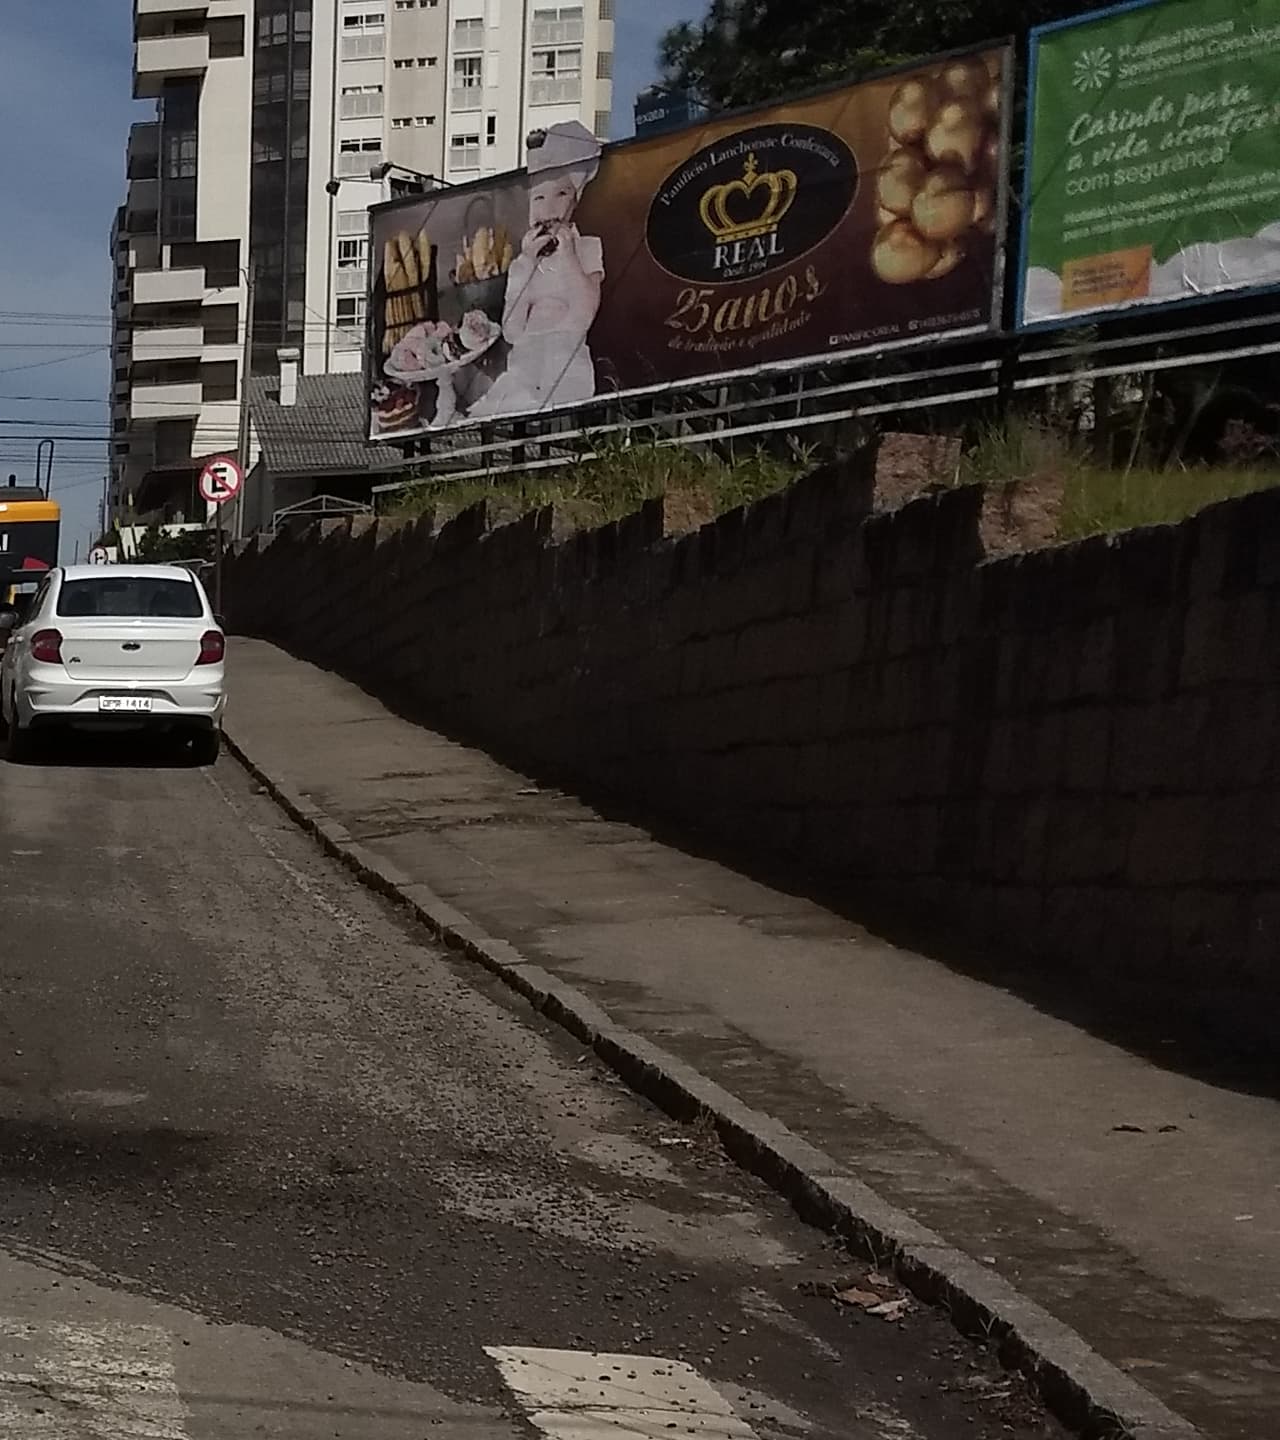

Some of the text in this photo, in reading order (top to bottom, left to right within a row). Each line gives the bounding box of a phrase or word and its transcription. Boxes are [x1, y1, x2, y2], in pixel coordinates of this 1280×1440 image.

[1068, 84, 1250, 146] Carinho para
[1067, 152, 1083, 171] a
[1093, 133, 1148, 167] vida
[1066, 173, 1110, 195] com
[713, 233, 785, 269] REAL
[664, 264, 828, 333] 25 anos
